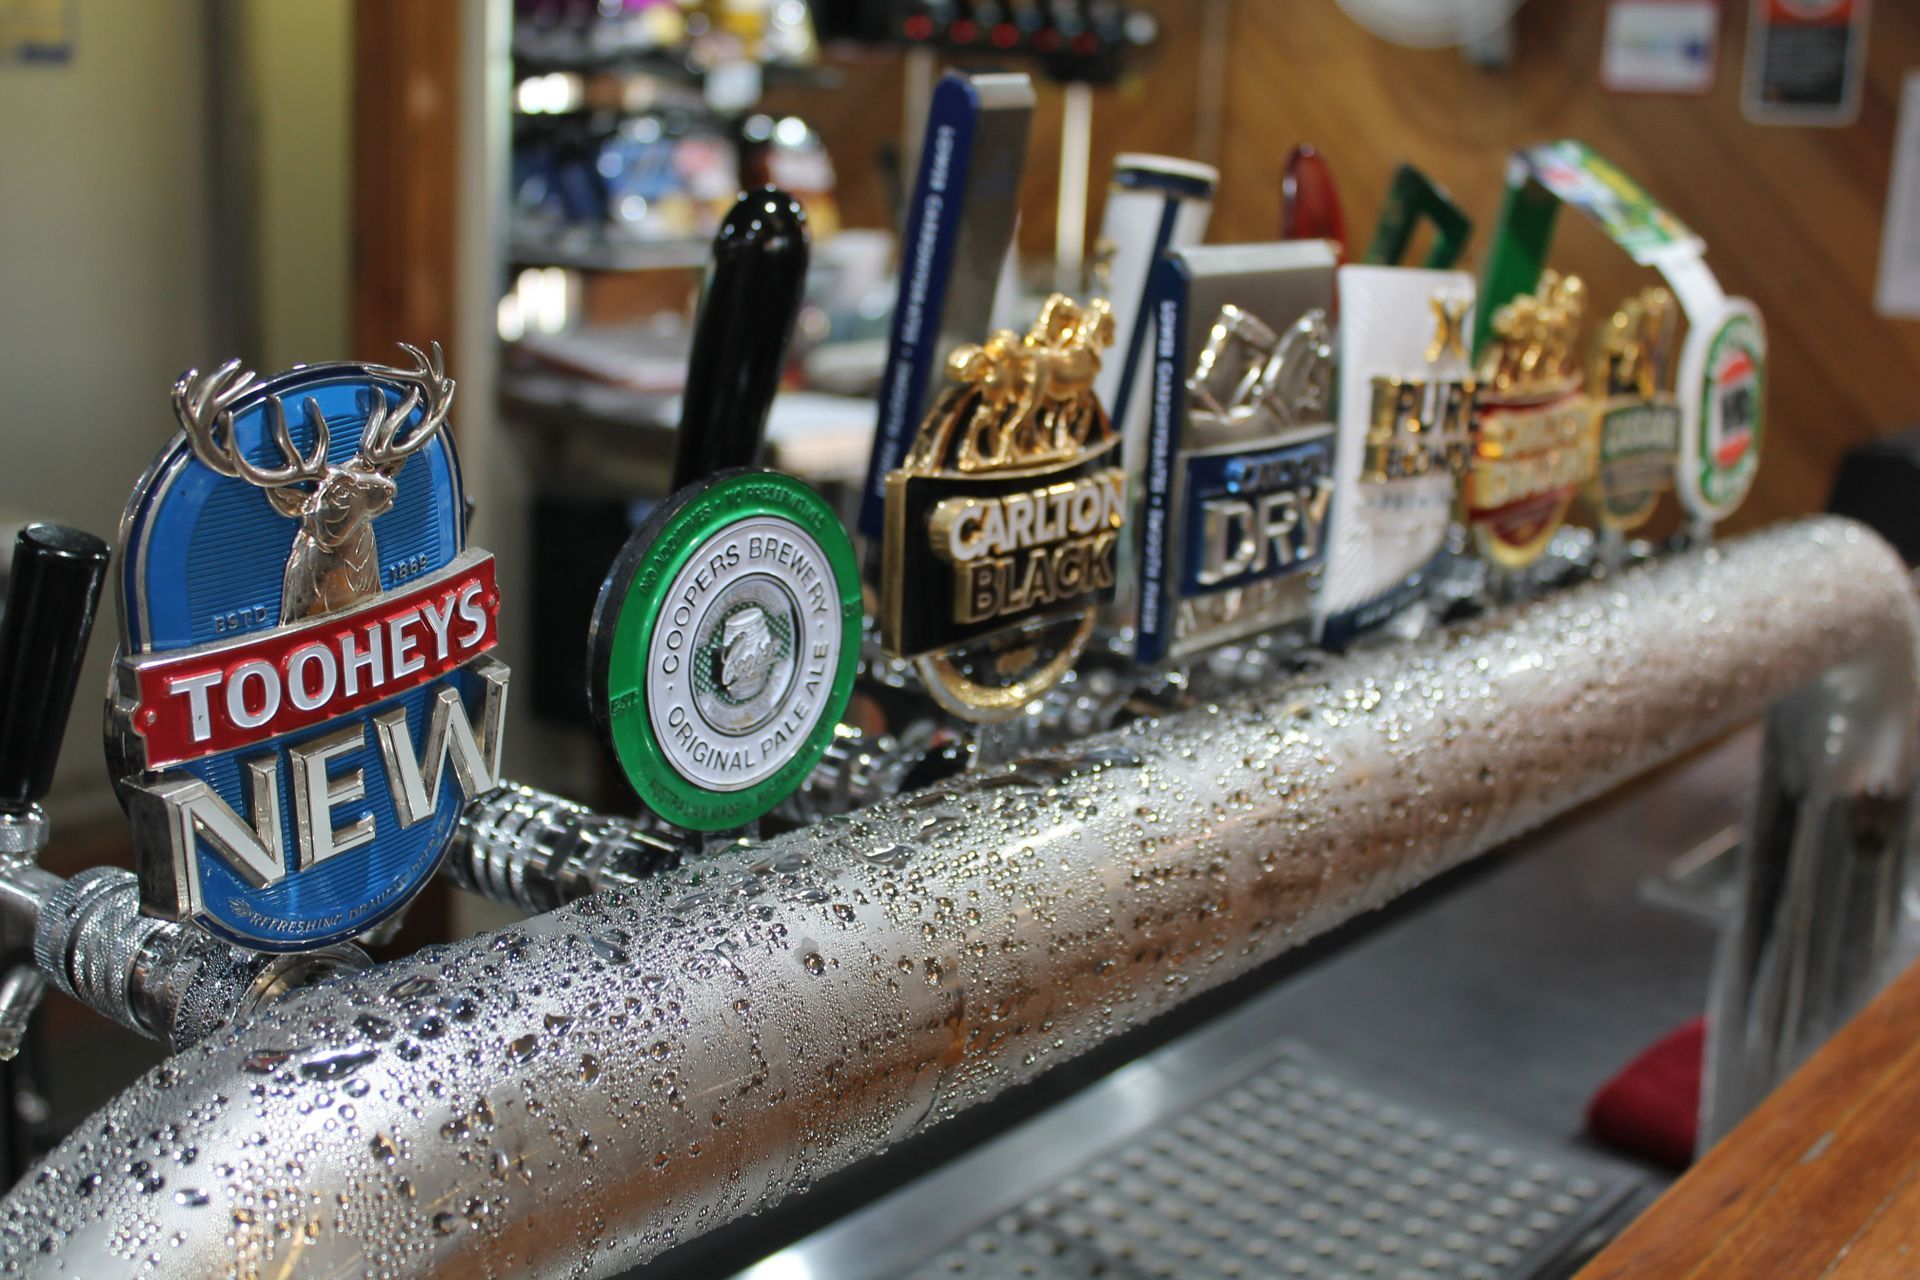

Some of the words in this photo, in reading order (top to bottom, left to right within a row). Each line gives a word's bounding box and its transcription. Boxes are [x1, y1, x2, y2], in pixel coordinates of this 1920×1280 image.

[1157, 300, 1177, 358] LOWER
[936, 470, 1129, 562] CARLTON
[1196, 477, 1335, 585] DRY
[213, 604, 269, 633] ESTD
[662, 543, 740, 675] COOPERS
[748, 537, 829, 615] BREWERY
[956, 531, 1118, 624] BLACK
[168, 579, 488, 743] TOOHEYS
[668, 706, 756, 772] ORIGINAL
[760, 702, 810, 760] PALE
[805, 643, 829, 698] ALE
[122, 655, 511, 923] NEW
